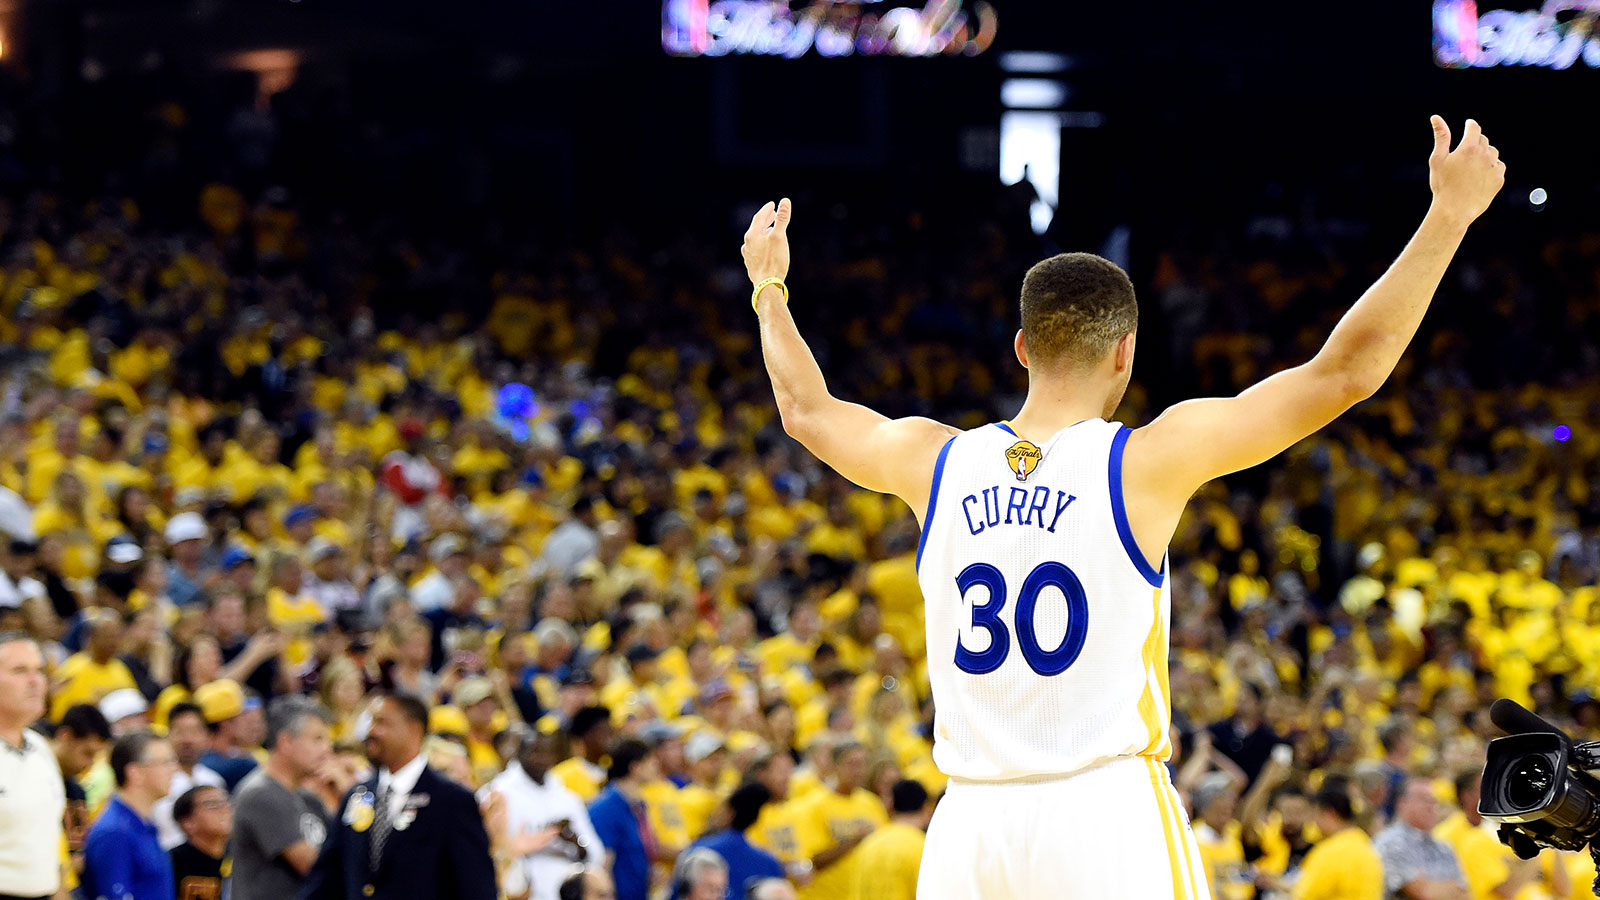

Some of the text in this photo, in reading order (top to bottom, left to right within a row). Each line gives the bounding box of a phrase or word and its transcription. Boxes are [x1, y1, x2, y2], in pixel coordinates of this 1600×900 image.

[1016, 446, 1040, 458] Finals
[962, 485, 1076, 536] CURRY
[954, 561, 1089, 677] 30
